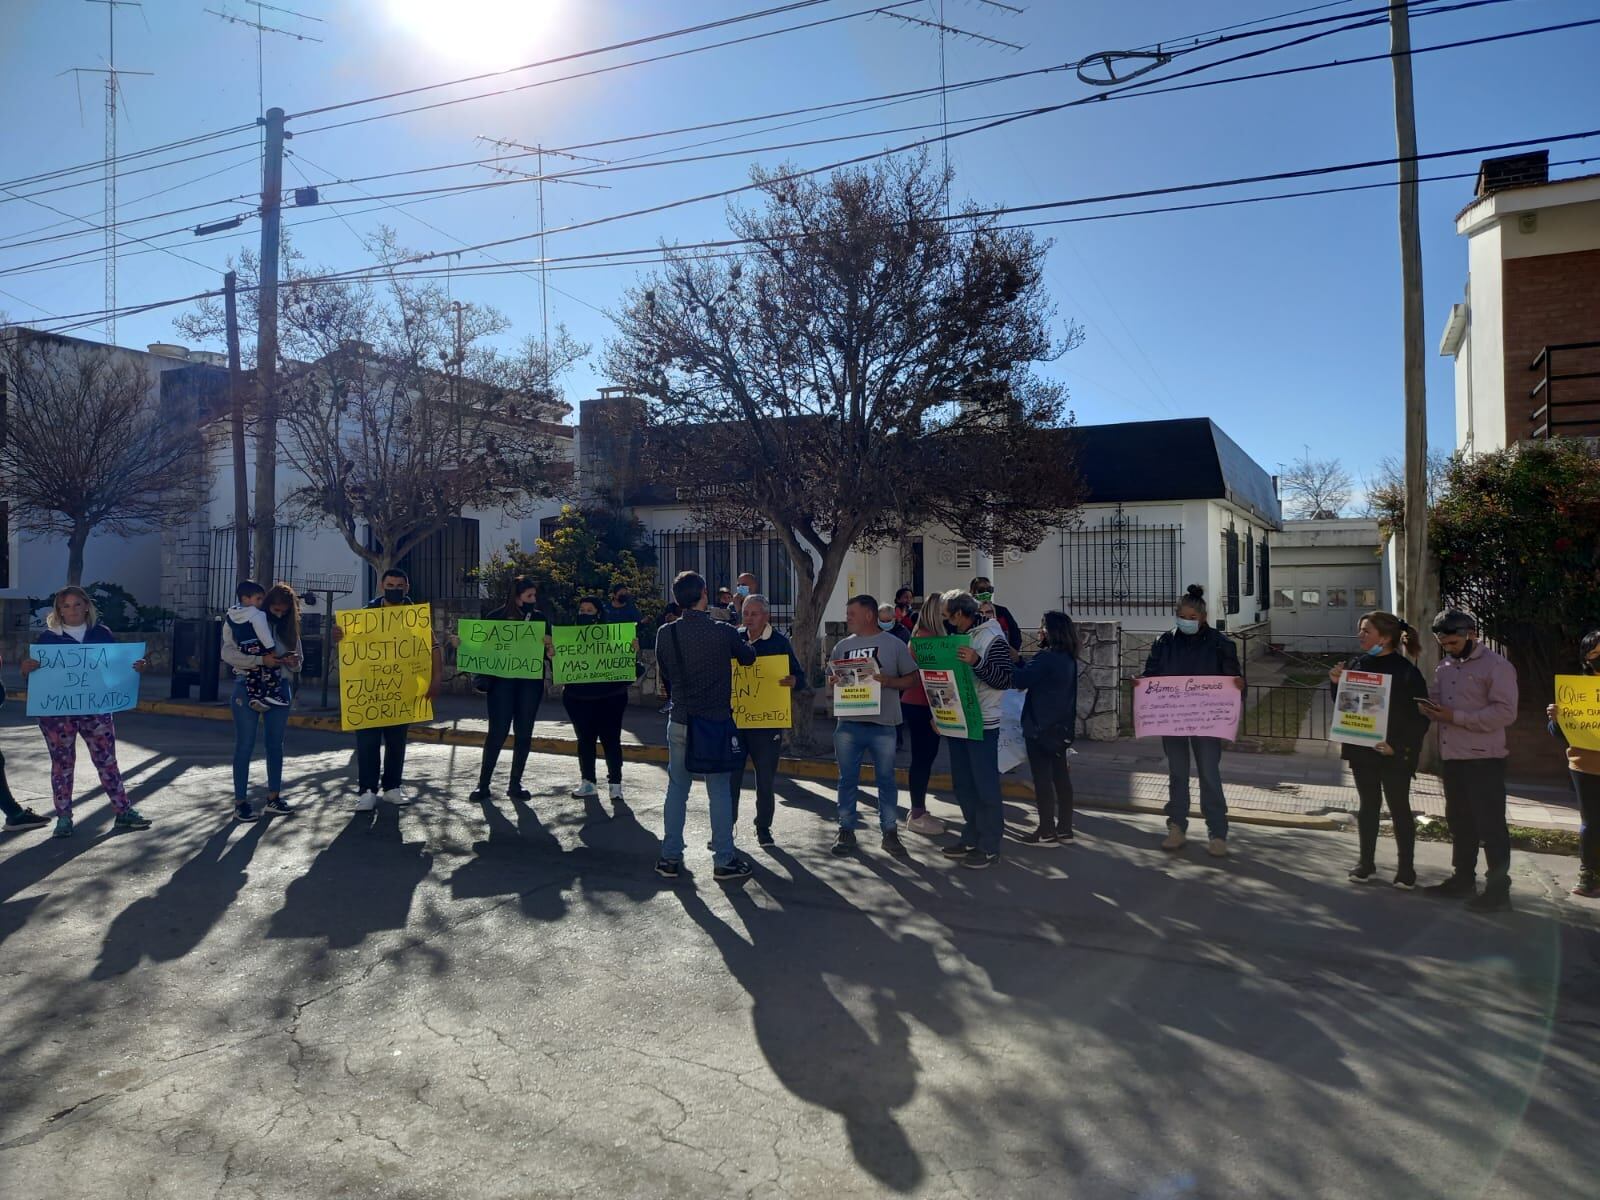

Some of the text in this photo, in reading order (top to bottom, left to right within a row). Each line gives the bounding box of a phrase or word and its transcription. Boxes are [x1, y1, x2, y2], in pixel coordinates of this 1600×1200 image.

[342, 607, 430, 635] PEDIMOS
[470, 623, 537, 643] BASTA
[343, 636, 431, 665] JUSTICIA
[495, 643, 511, 651] DE
[848, 647, 876, 659] JUST
[37, 647, 109, 669] BASTA
[459, 654, 543, 673] IMPUNIDAD
[562, 660, 590, 673] MAS
[369, 664, 402, 676] POR
[64, 672, 89, 688] DE
[346, 674, 404, 699] JUAN
[40, 692, 131, 710] MALTRATOS
[357, 692, 402, 706] CARLOS
[347, 695, 429, 725] SORIA!!!
[745, 708, 789, 722] RESPETO!
